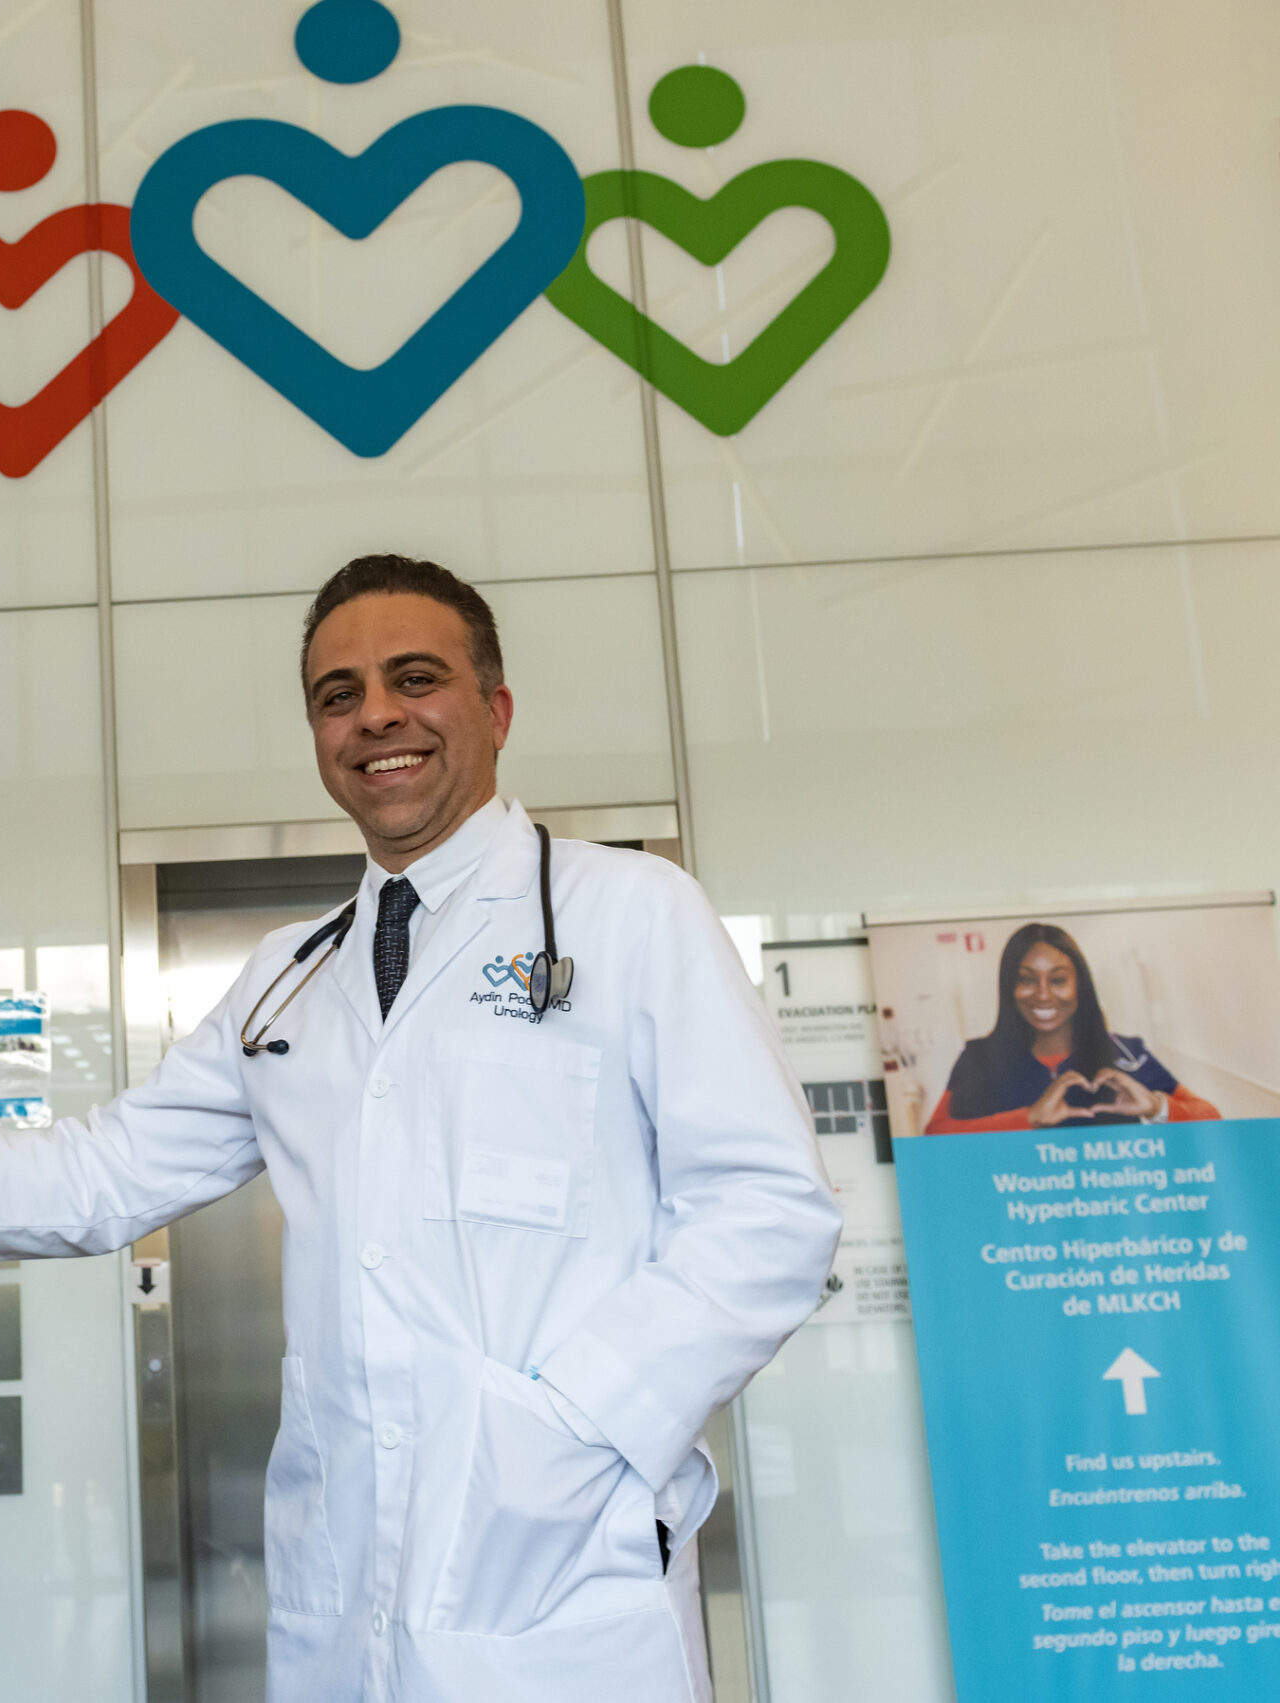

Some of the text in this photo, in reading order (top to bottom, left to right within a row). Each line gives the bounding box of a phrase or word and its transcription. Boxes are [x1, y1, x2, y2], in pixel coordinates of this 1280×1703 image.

[775, 961, 790, 997] 1
[469, 991, 502, 1004] Aydin
[494, 1005, 544, 1025] Urology
[778, 1005, 854, 1019] EVACUATION
[1036, 1138, 1165, 1163] The MLKCH
[993, 1163, 1215, 1193] Wound Healing and
[1007, 1192, 1208, 1225] Hyperbaric Center
[981, 1231, 1247, 1264] Centro Hiperbárico y de
[1006, 1260, 1230, 1290] Curación de Heridas
[1063, 1291, 1181, 1317] de MLKCH
[1066, 1449, 1221, 1473] Find us upstairs.
[1049, 1480, 1246, 1508] Encuéntrenos arriba.
[1040, 1533, 1270, 1561] Take the elevator to the
[1020, 1568, 1086, 1589] second
[1093, 1566, 1144, 1586] floor,
[1148, 1563, 1193, 1583] then
[1198, 1562, 1240, 1581] turn
[1041, 1602, 1093, 1622] Tome
[1098, 1600, 1116, 1619] el
[1121, 1600, 1206, 1618] ascensor
[1211, 1595, 1264, 1614] hasta
[1033, 1629, 1116, 1652] segundo
[1122, 1626, 1162, 1649] piso
[1168, 1629, 1180, 1647] y
[1185, 1623, 1241, 1646] luego
[1118, 1650, 1223, 1672] la derecha.
